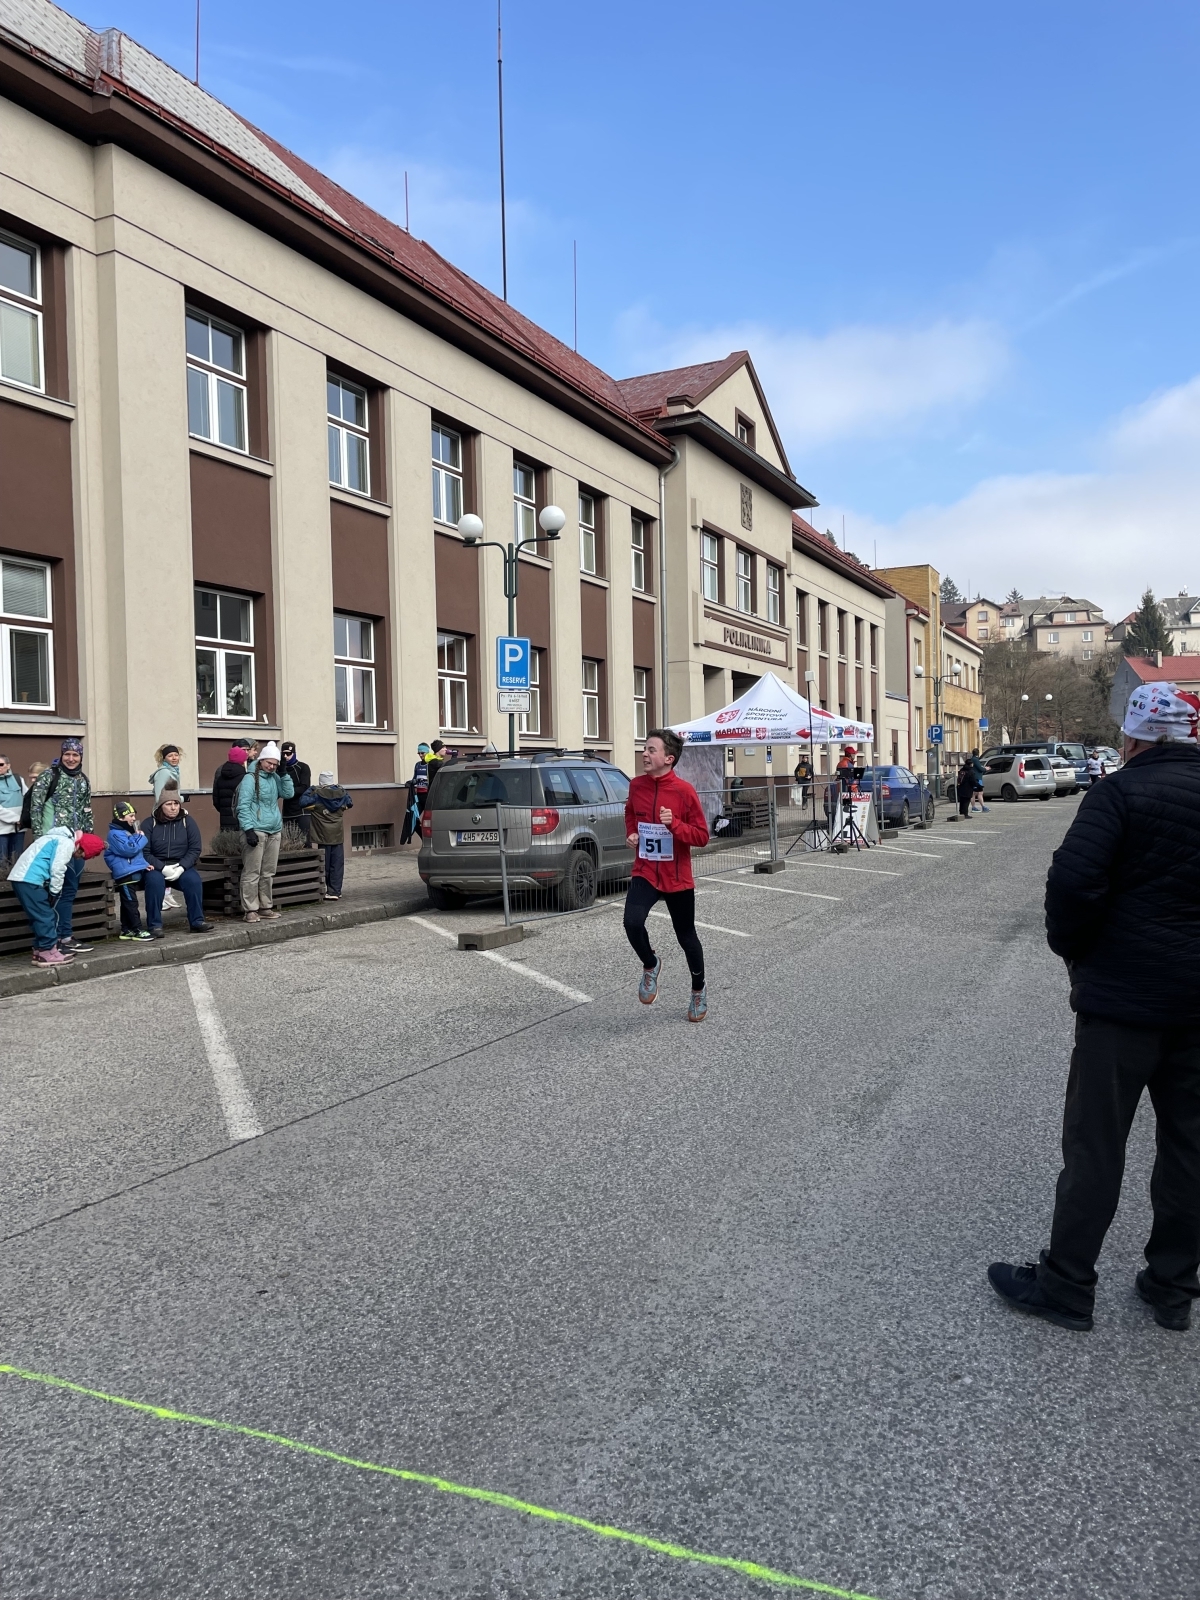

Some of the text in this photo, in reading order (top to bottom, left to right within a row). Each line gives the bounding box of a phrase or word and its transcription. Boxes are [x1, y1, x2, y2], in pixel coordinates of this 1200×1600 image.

[724, 627, 772, 655] POLIKLINIKA
[505, 644, 523, 672] P
[502, 676, 526, 684] RESERVÉ
[715, 727, 751, 735] MARATON
[932, 727, 940, 738] P
[463, 832, 497, 841] 4H5 2459
[646, 838, 662, 853] 51
